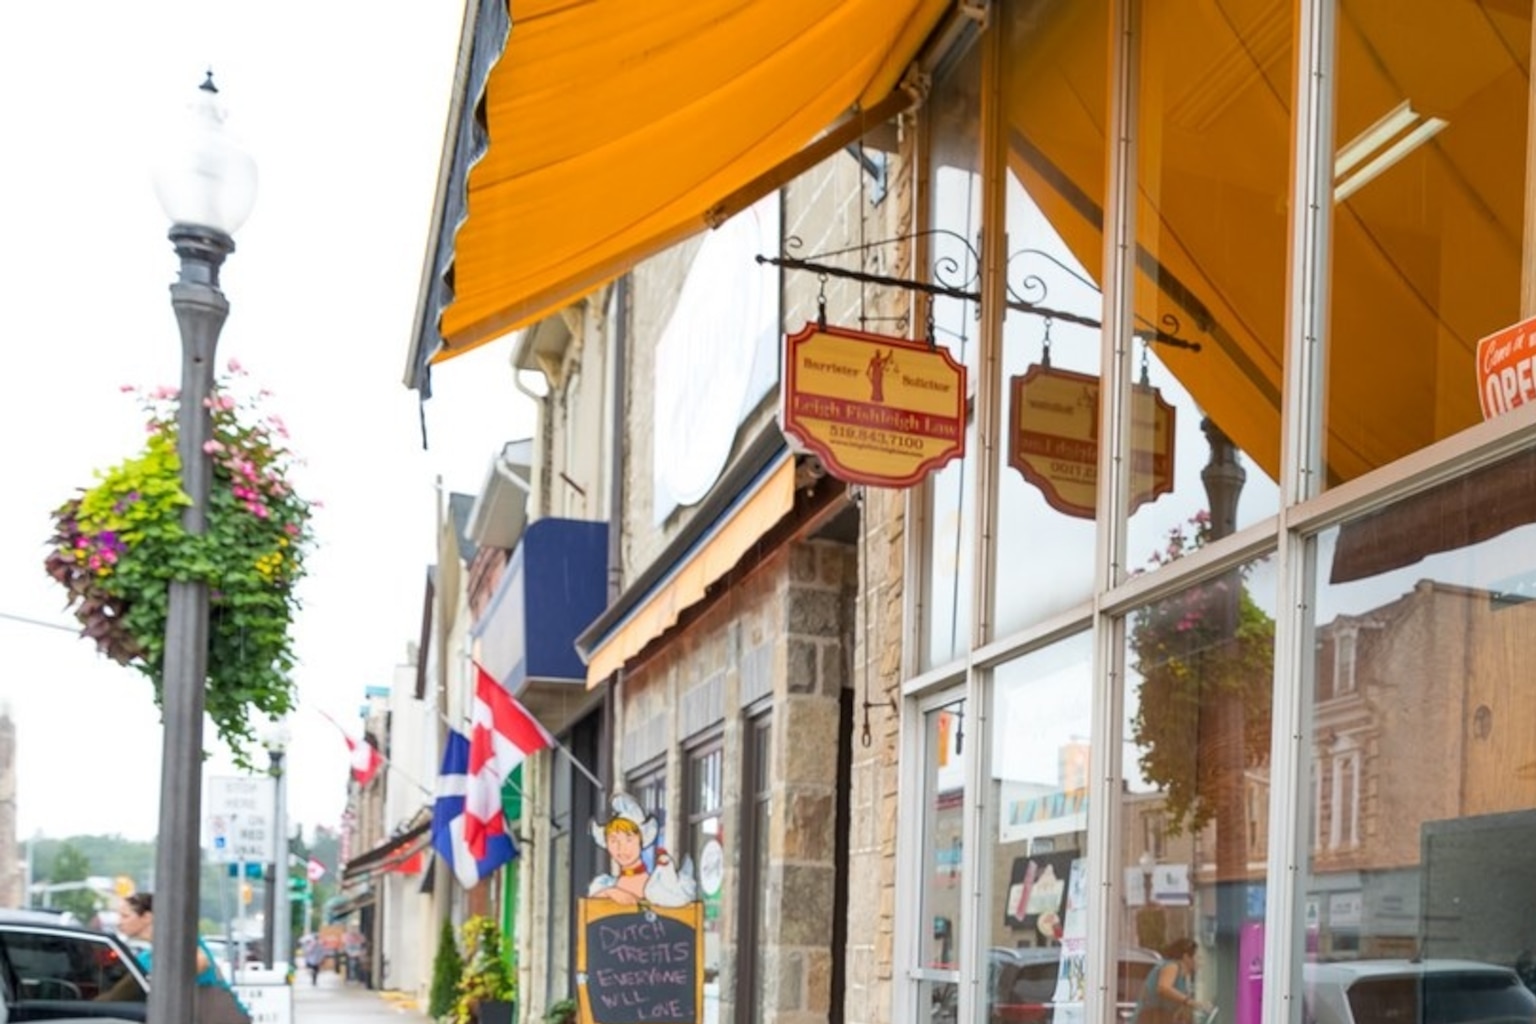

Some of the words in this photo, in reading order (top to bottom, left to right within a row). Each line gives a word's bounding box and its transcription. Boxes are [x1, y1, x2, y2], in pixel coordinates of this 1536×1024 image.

[803, 357, 860, 378] Barrister
[902, 375, 950, 393] Solicitor
[794, 396, 840, 418] Leigh
[846, 402, 920, 430] Fishleigh
[924, 416, 958, 434] Law
[597, 966, 687, 988] EVERYONE
